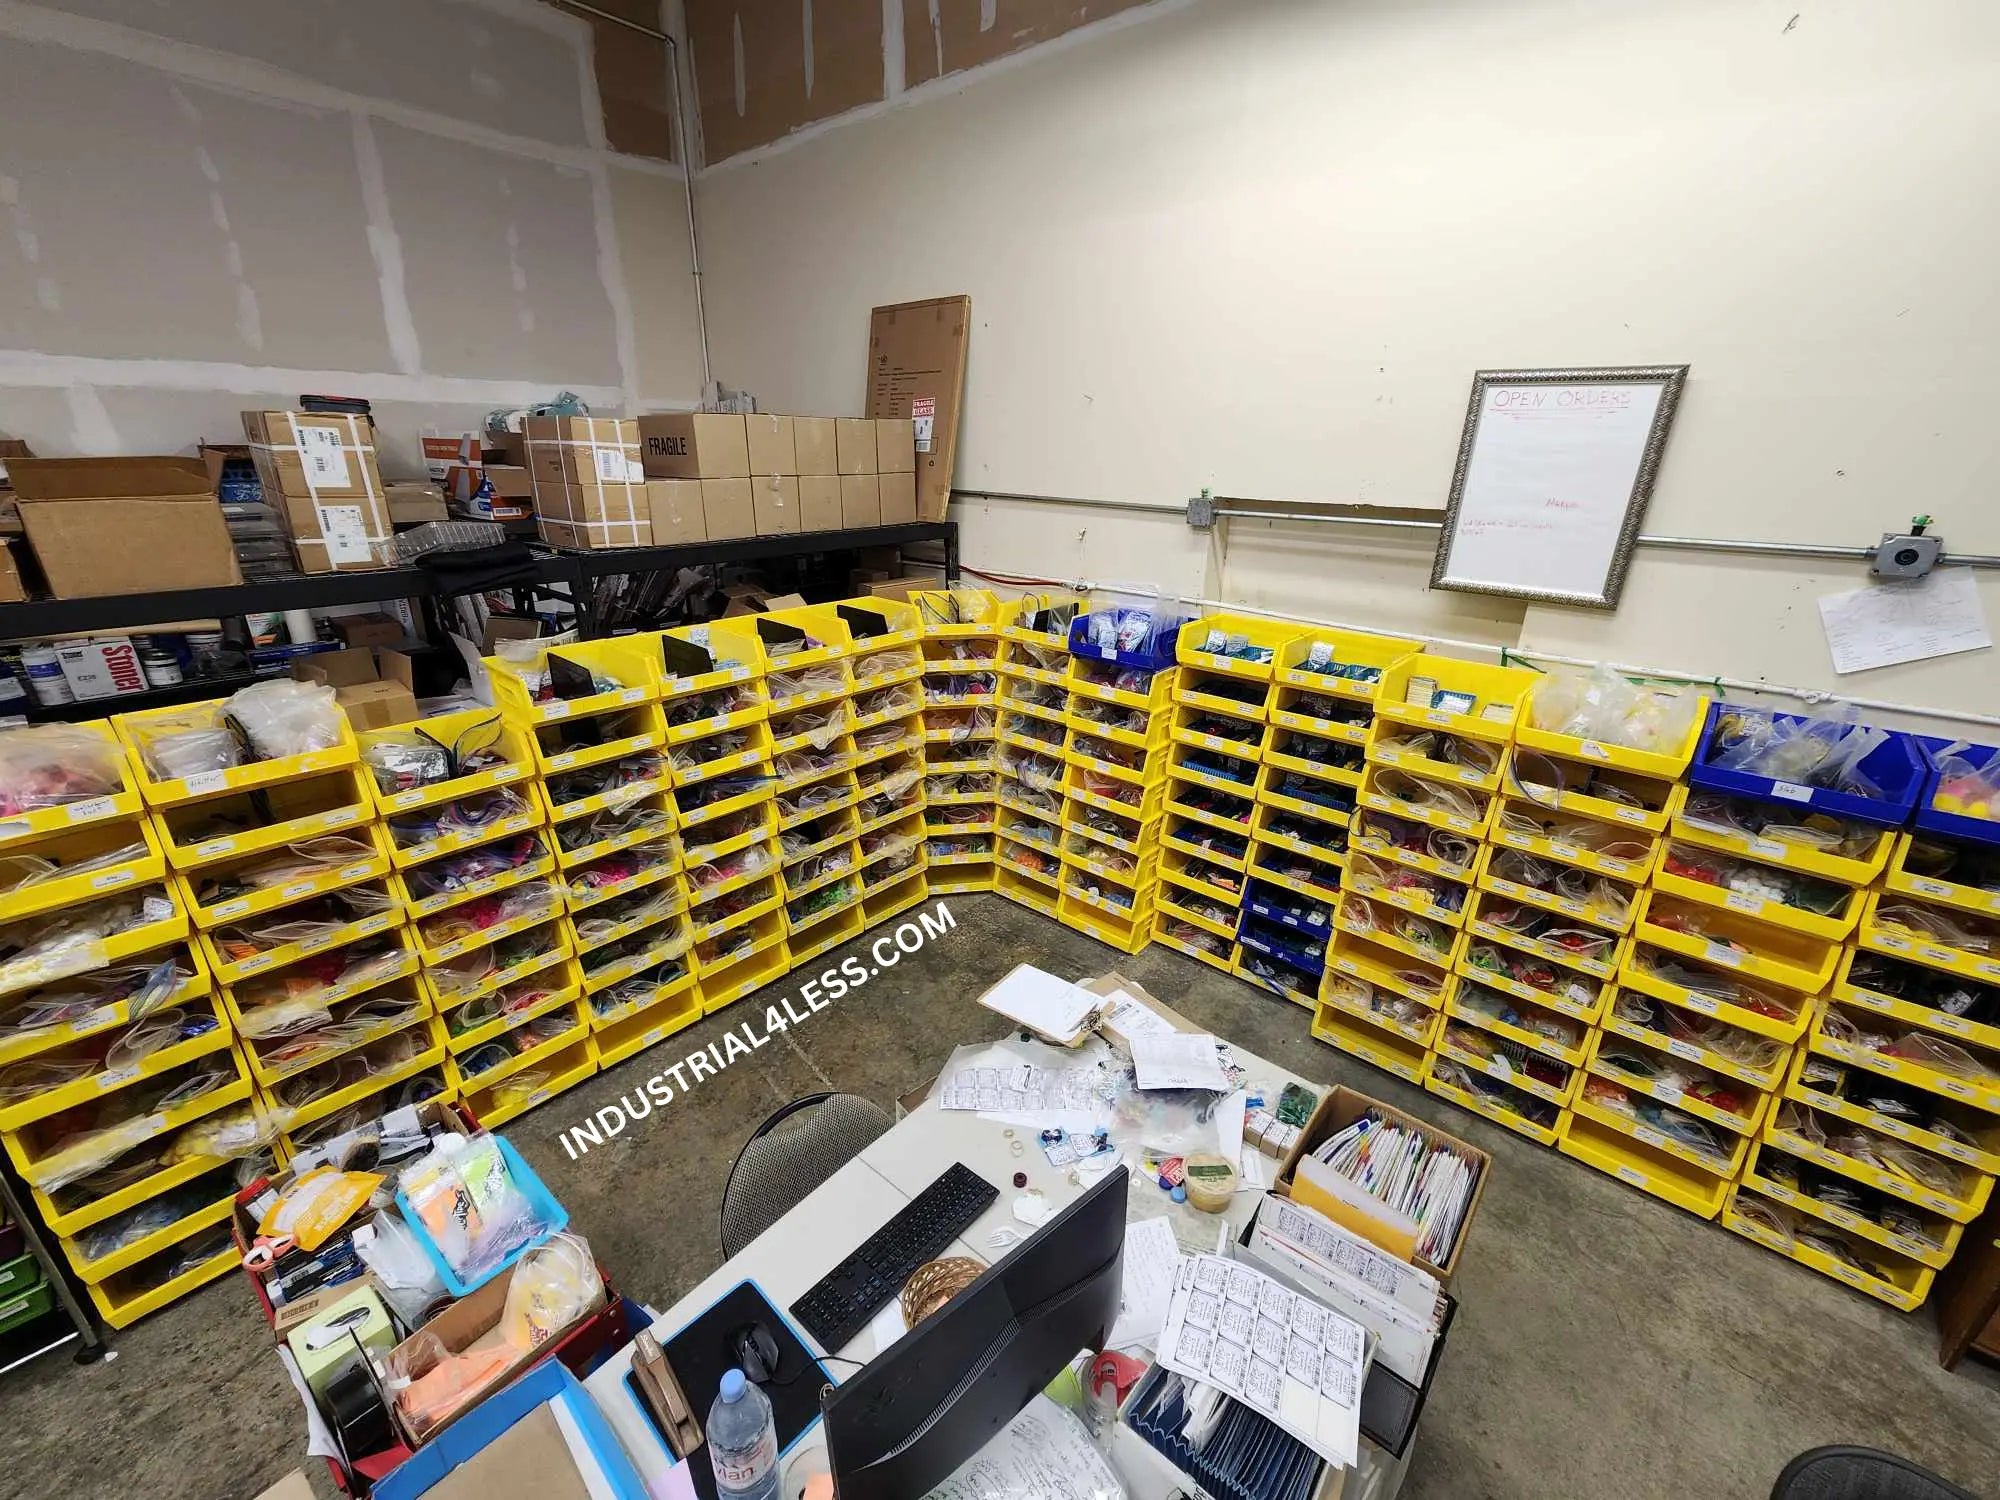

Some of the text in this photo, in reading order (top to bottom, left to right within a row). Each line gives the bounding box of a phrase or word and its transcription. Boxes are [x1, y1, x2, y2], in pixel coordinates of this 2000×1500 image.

[1494, 390, 1632, 408] OPEN ORDERS
[648, 437, 687, 456] FRAGILE
[101, 645, 144, 692] Stoner
